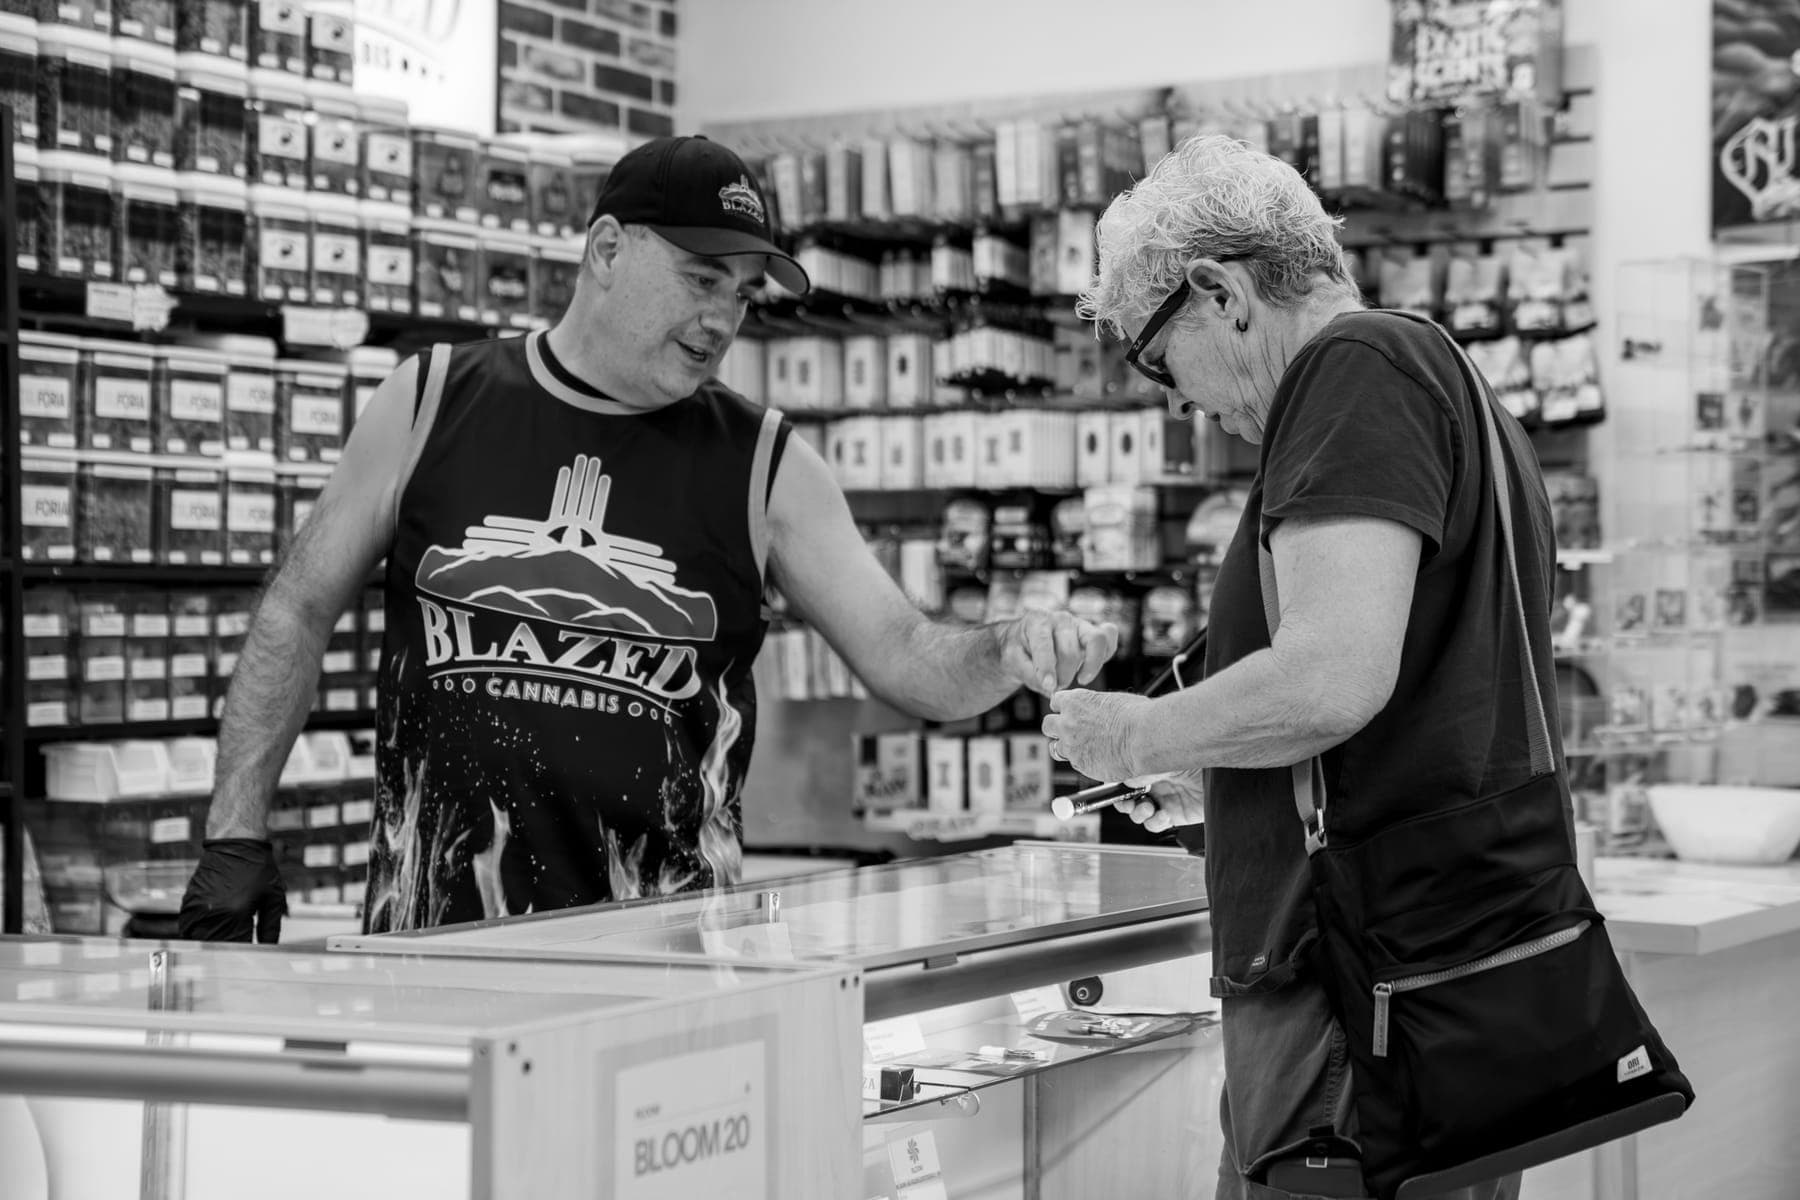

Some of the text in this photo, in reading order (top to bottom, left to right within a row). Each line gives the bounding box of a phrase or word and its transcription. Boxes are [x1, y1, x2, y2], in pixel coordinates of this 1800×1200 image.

[416, 596, 702, 700] BLAZED
[486, 677, 620, 714] CANNABIS
[634, 1113, 751, 1177] BLOOM 20
